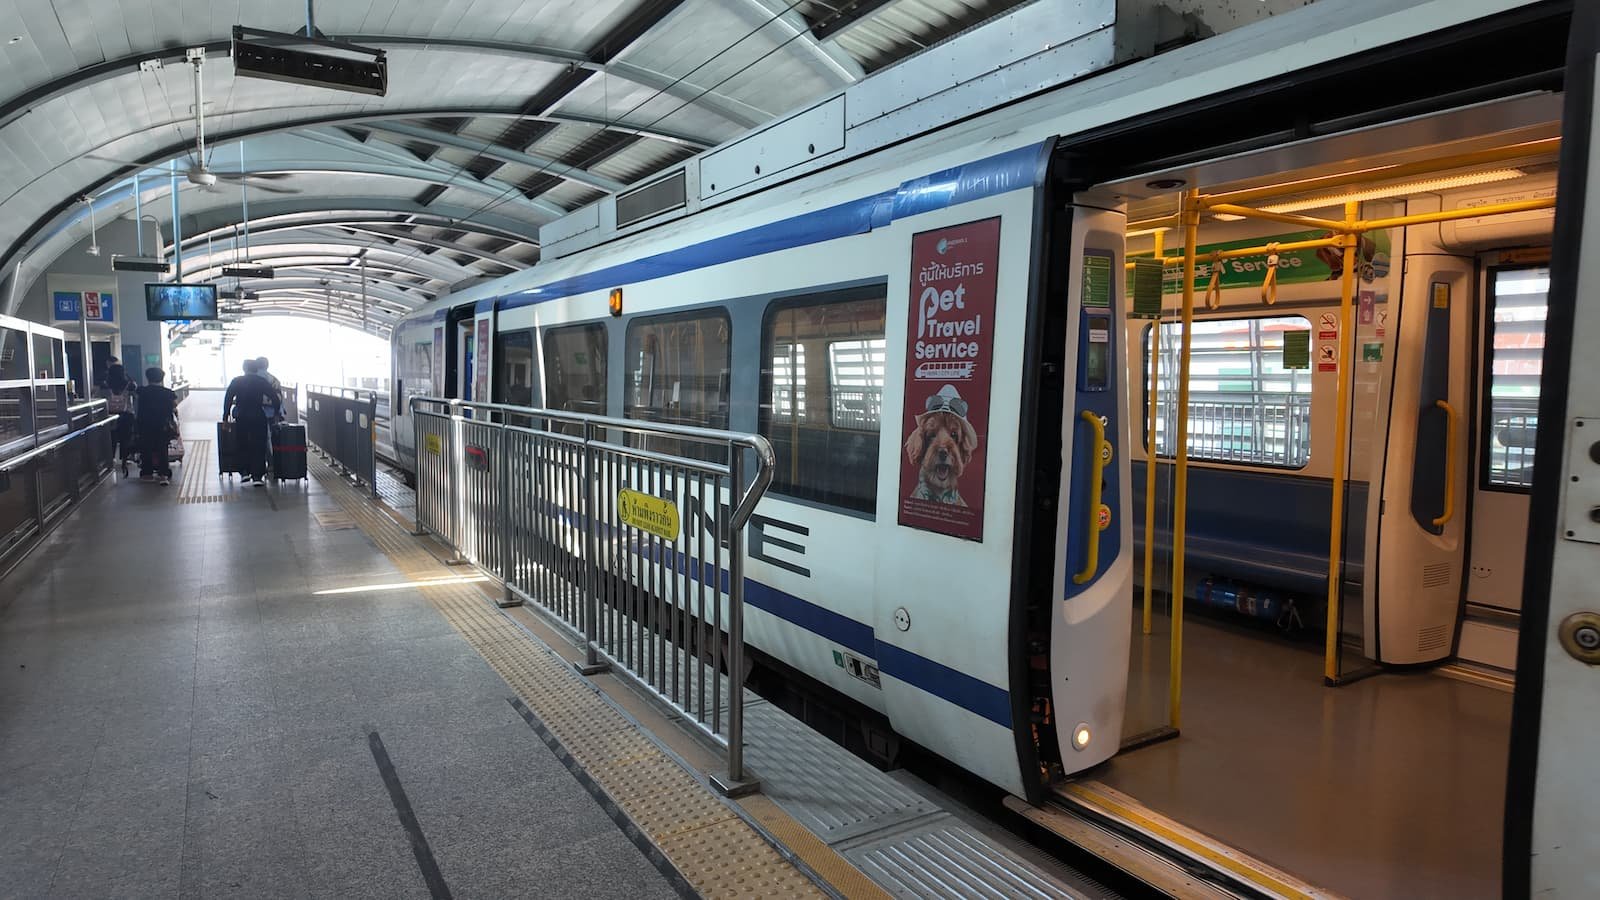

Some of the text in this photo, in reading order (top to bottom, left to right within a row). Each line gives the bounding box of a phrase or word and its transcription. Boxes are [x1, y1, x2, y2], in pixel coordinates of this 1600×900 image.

[919, 261, 984, 287] ตู้นี้ให้บริการ
[1231, 257, 1302, 273] Servce
[917, 283, 966, 339] Pet
[927, 314, 981, 338] Travel
[915, 337, 979, 359] Service
